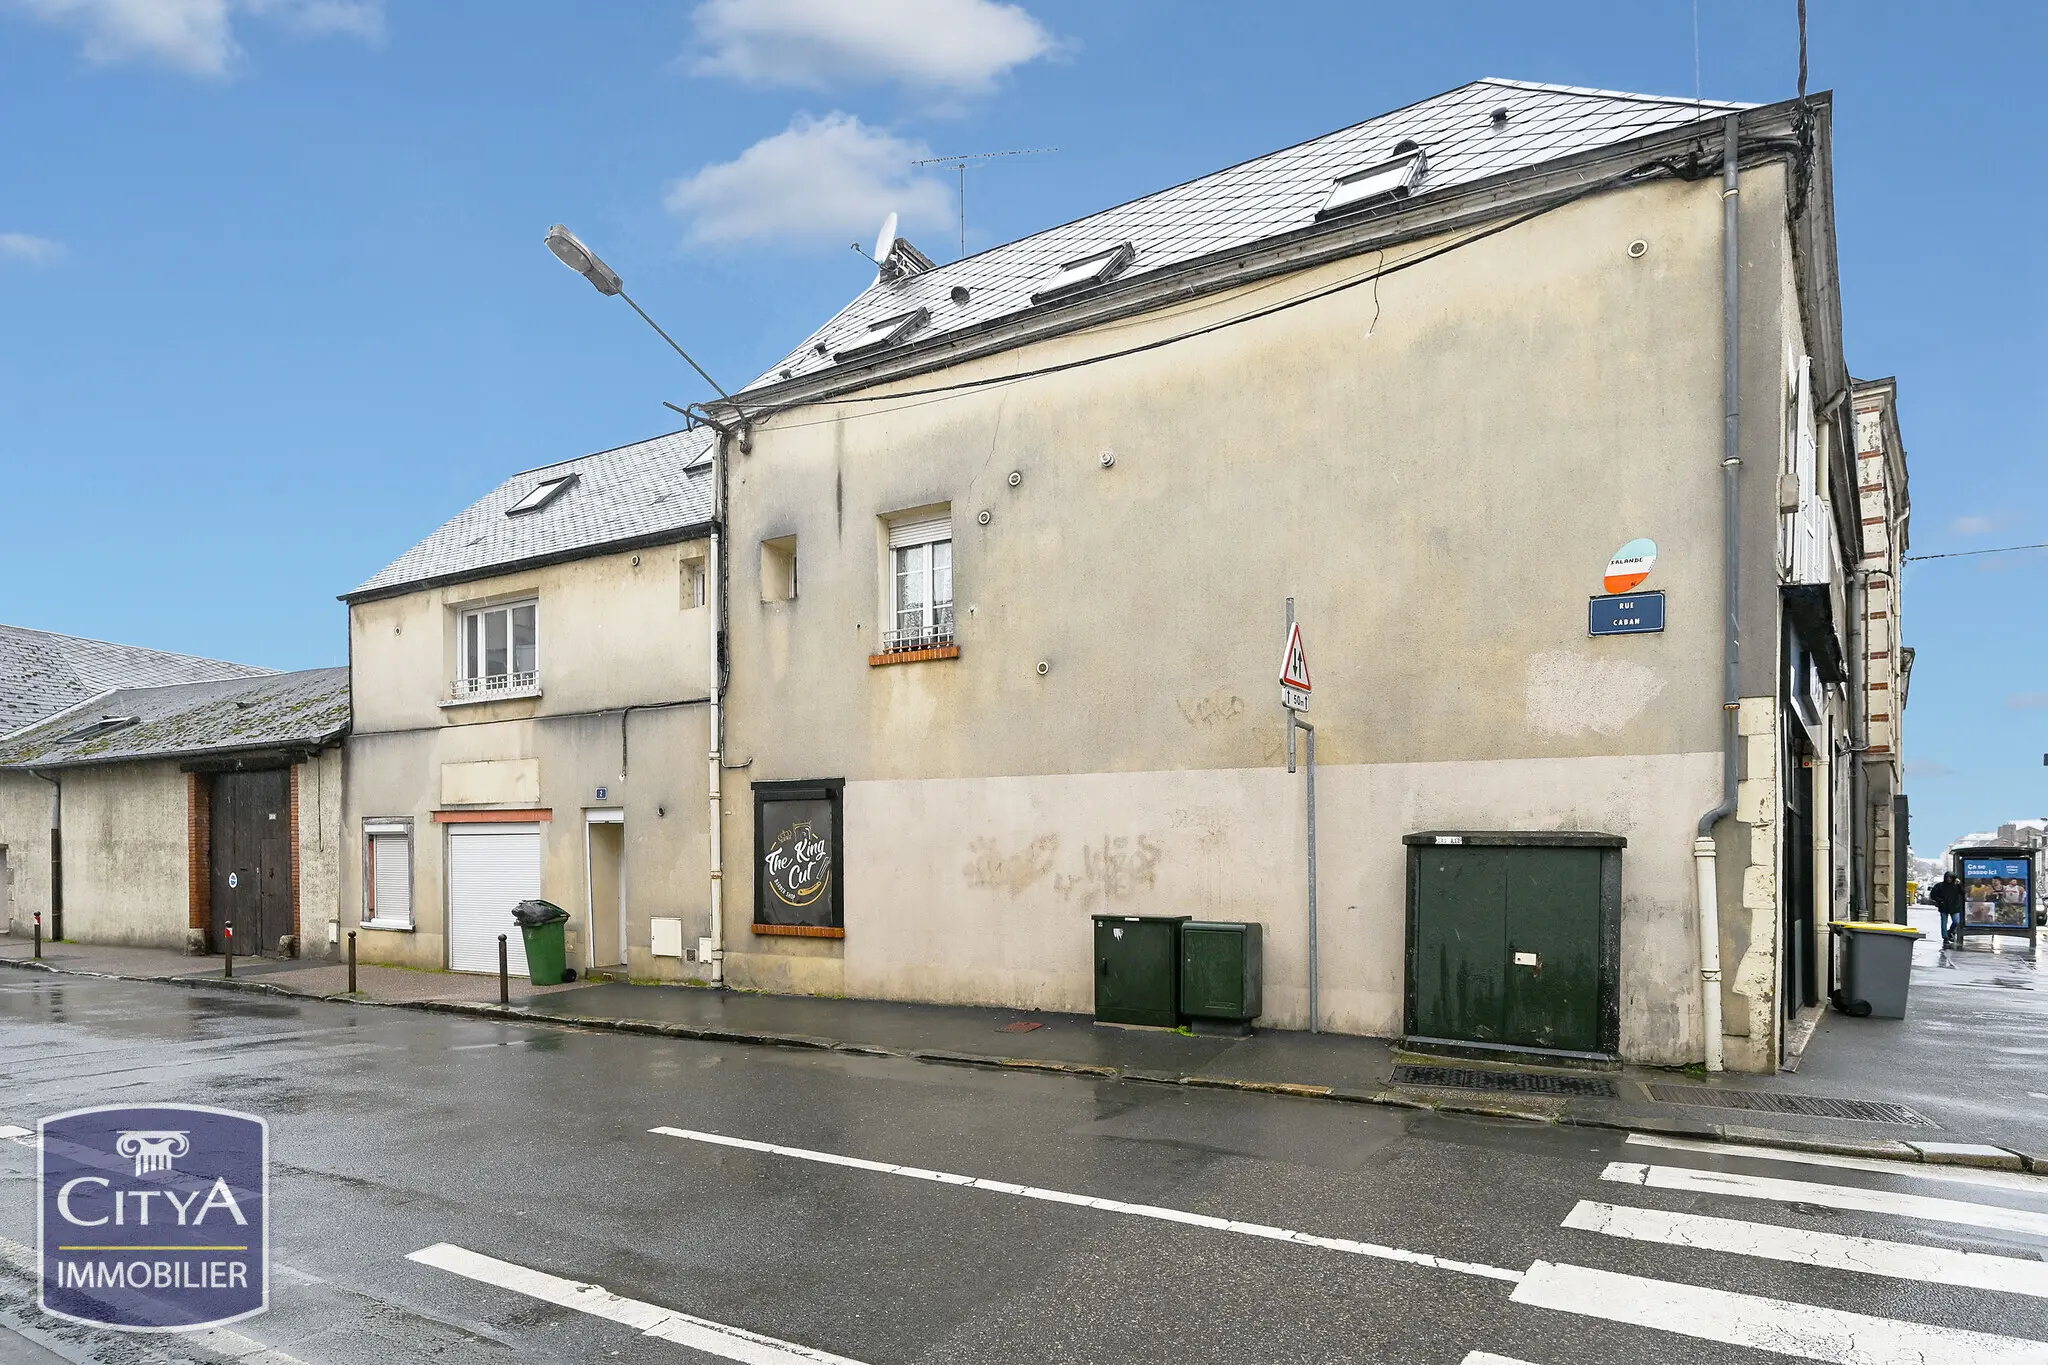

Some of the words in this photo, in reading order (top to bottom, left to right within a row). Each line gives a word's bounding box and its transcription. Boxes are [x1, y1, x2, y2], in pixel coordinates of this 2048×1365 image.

[1613, 618, 1640, 626] CABAN
[765, 847, 793, 876] The
[794, 838, 826, 863] King
[788, 861, 816, 890] Cut
